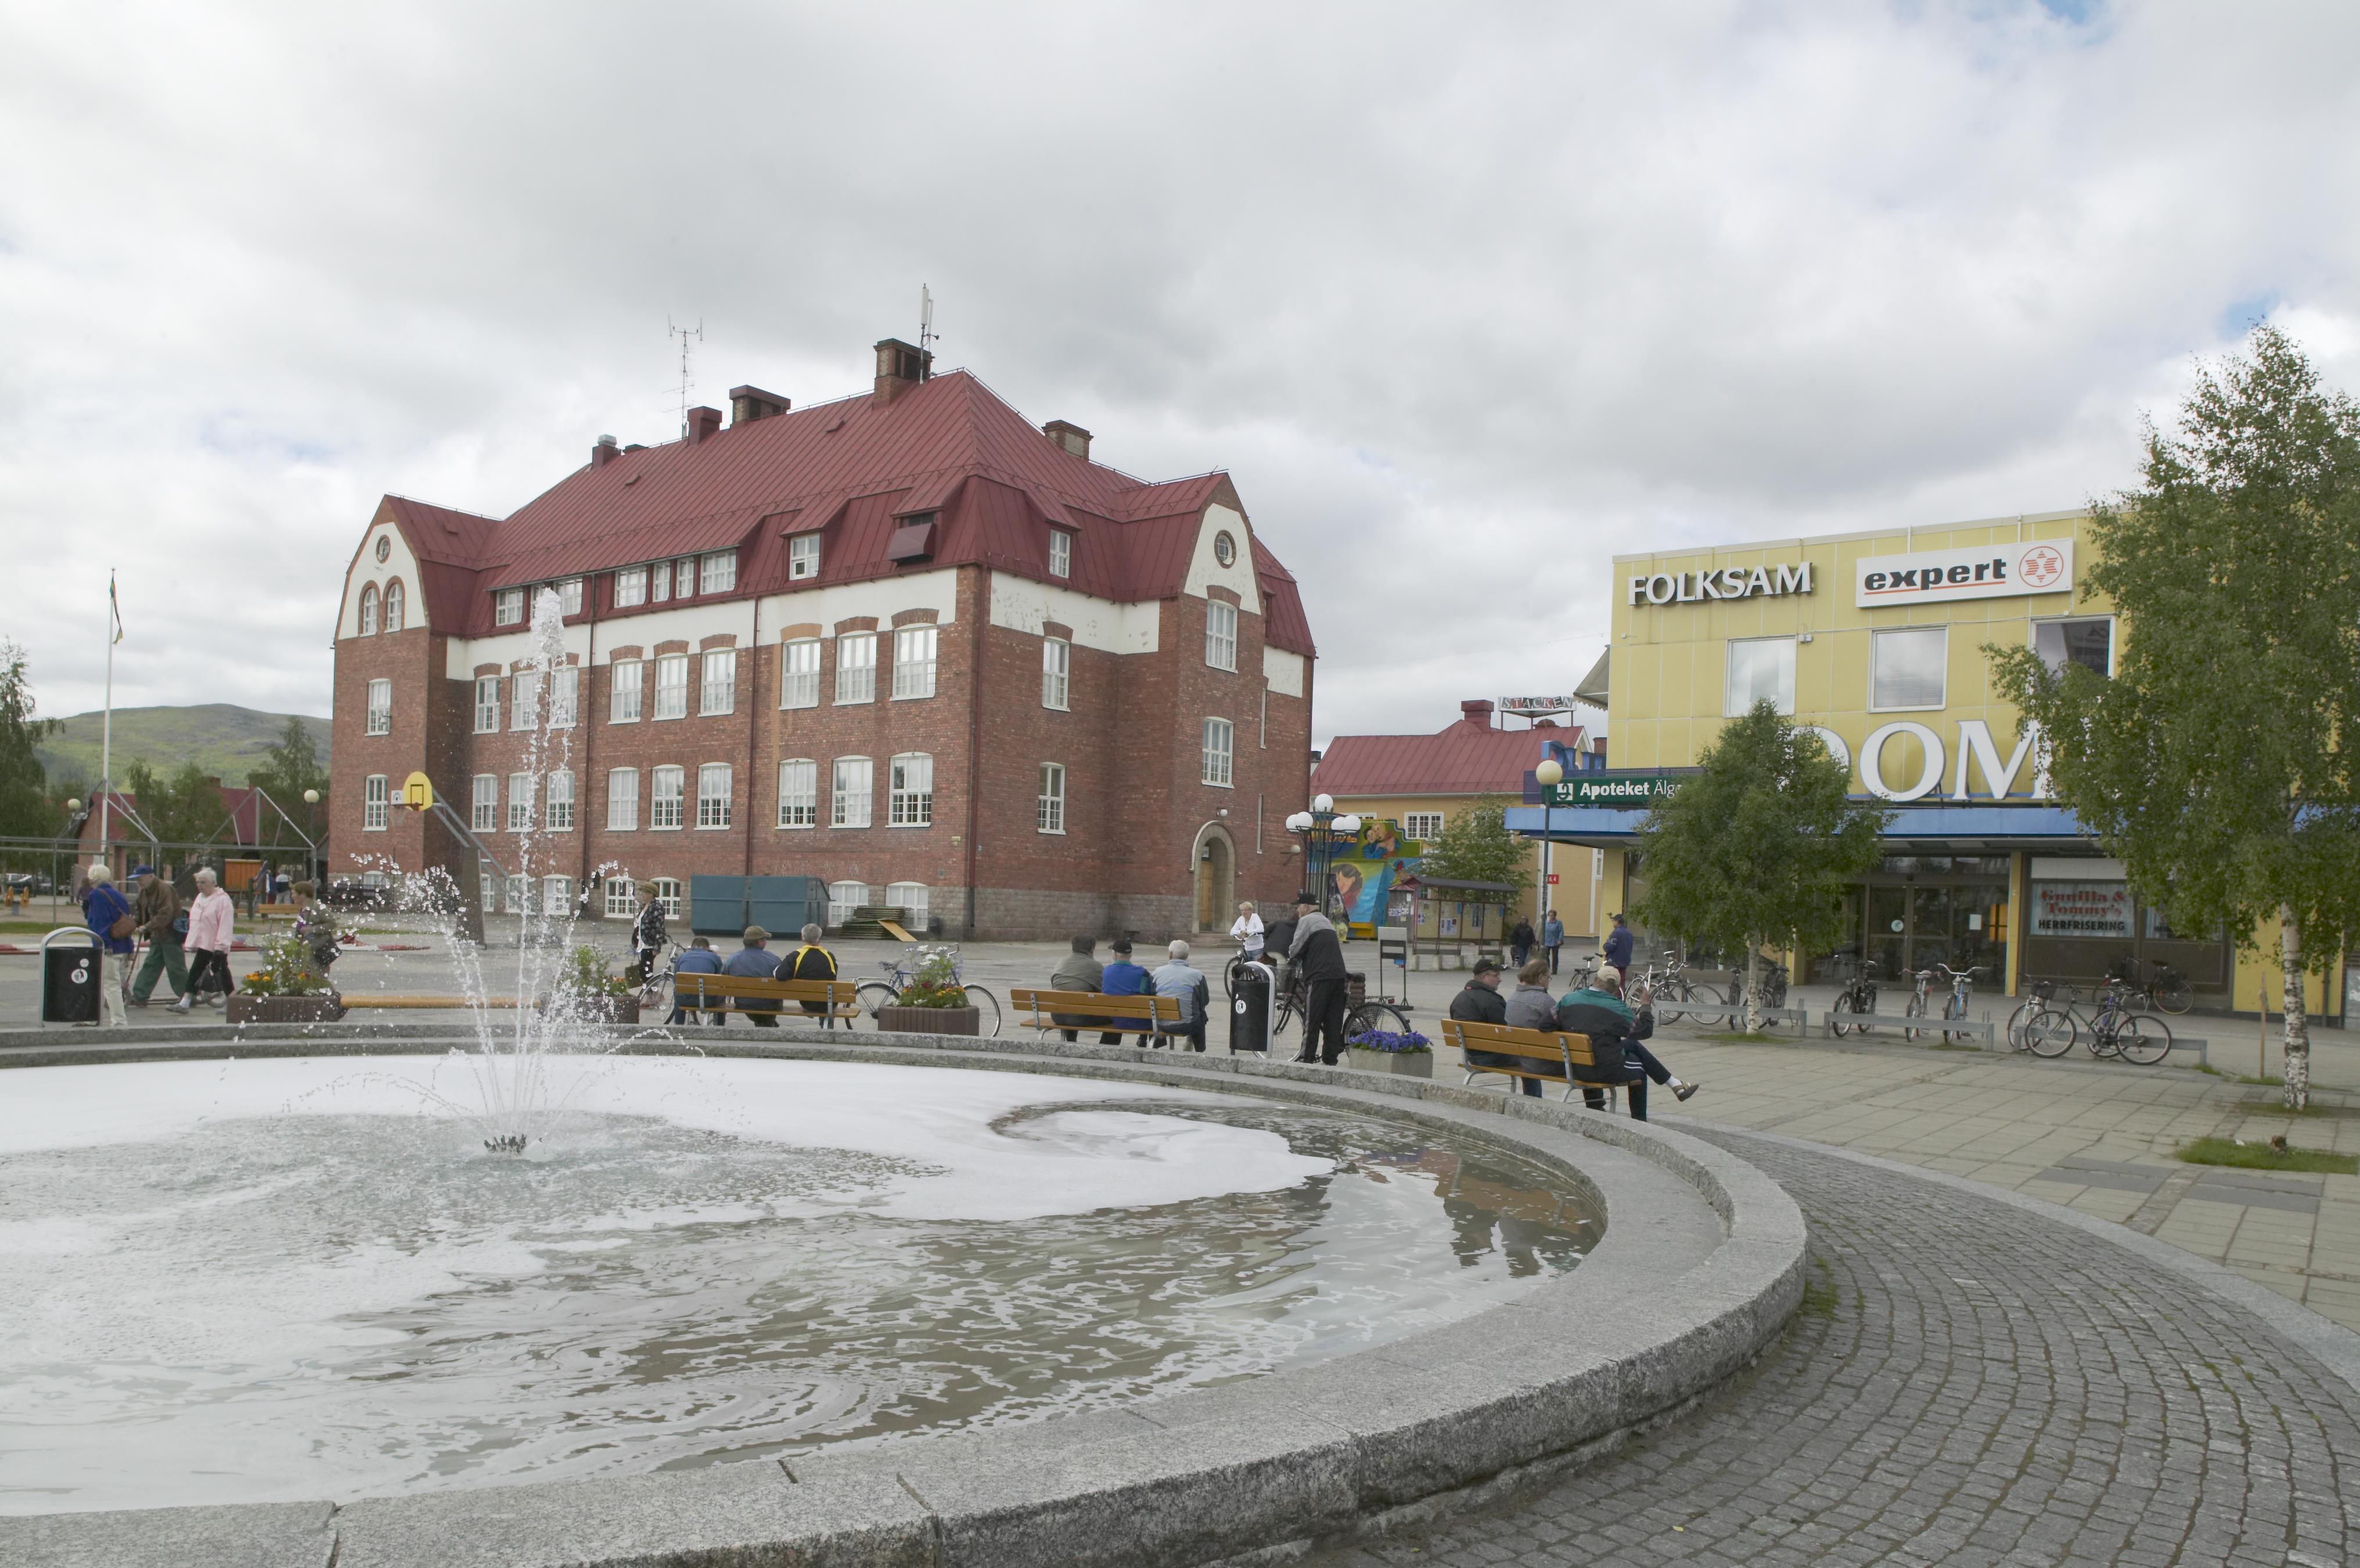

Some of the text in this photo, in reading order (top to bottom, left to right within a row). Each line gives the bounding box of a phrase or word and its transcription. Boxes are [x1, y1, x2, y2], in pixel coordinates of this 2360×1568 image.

[1864, 558, 2007, 591] expert
[1628, 562, 1812, 605] FOLKSAM
[1503, 697, 1573, 709] STACKEN
[1580, 781, 1649, 800] Apoteket
[2041, 890, 2107, 902] Gunilla
[2047, 901, 2122, 916] Tommy's
[2038, 919, 2125, 931] HERRFRISERING
